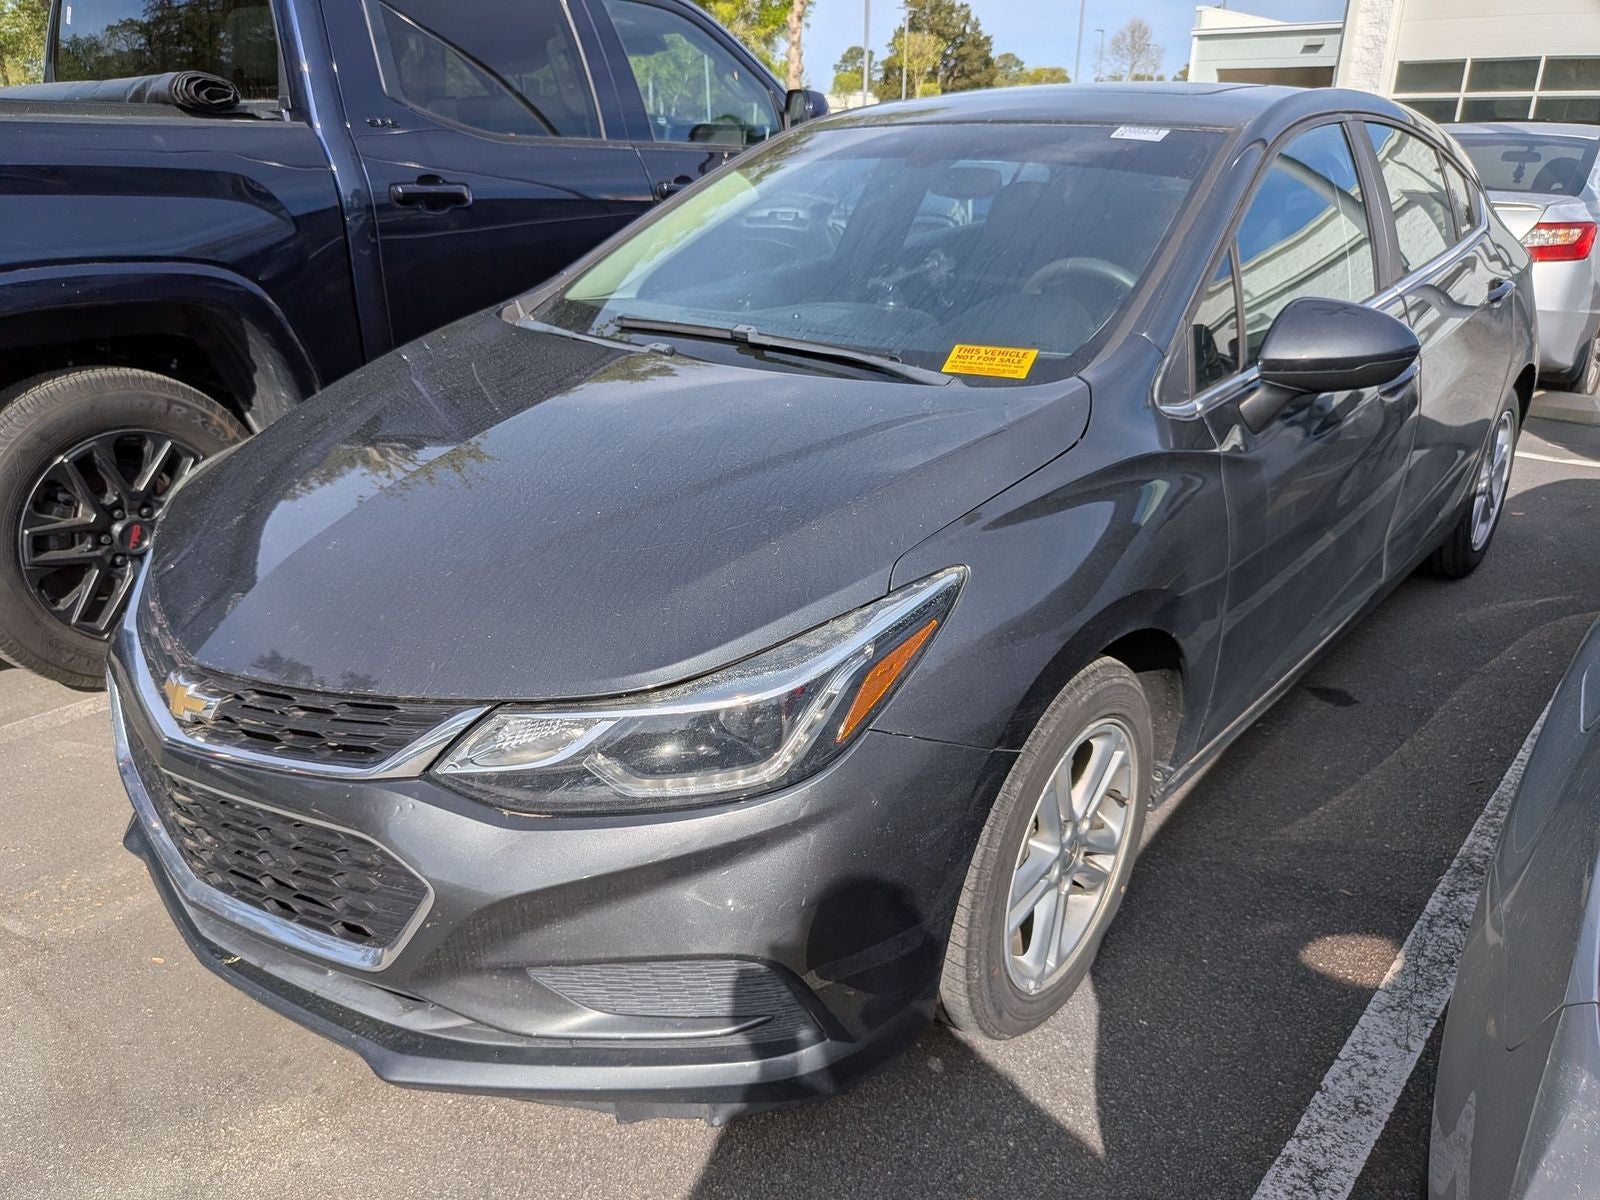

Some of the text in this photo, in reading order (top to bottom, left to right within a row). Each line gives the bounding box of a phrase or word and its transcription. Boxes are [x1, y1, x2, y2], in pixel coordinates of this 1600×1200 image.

[957, 347, 1029, 359] THIS VEHICLE
[999, 357, 1024, 365] SALE
